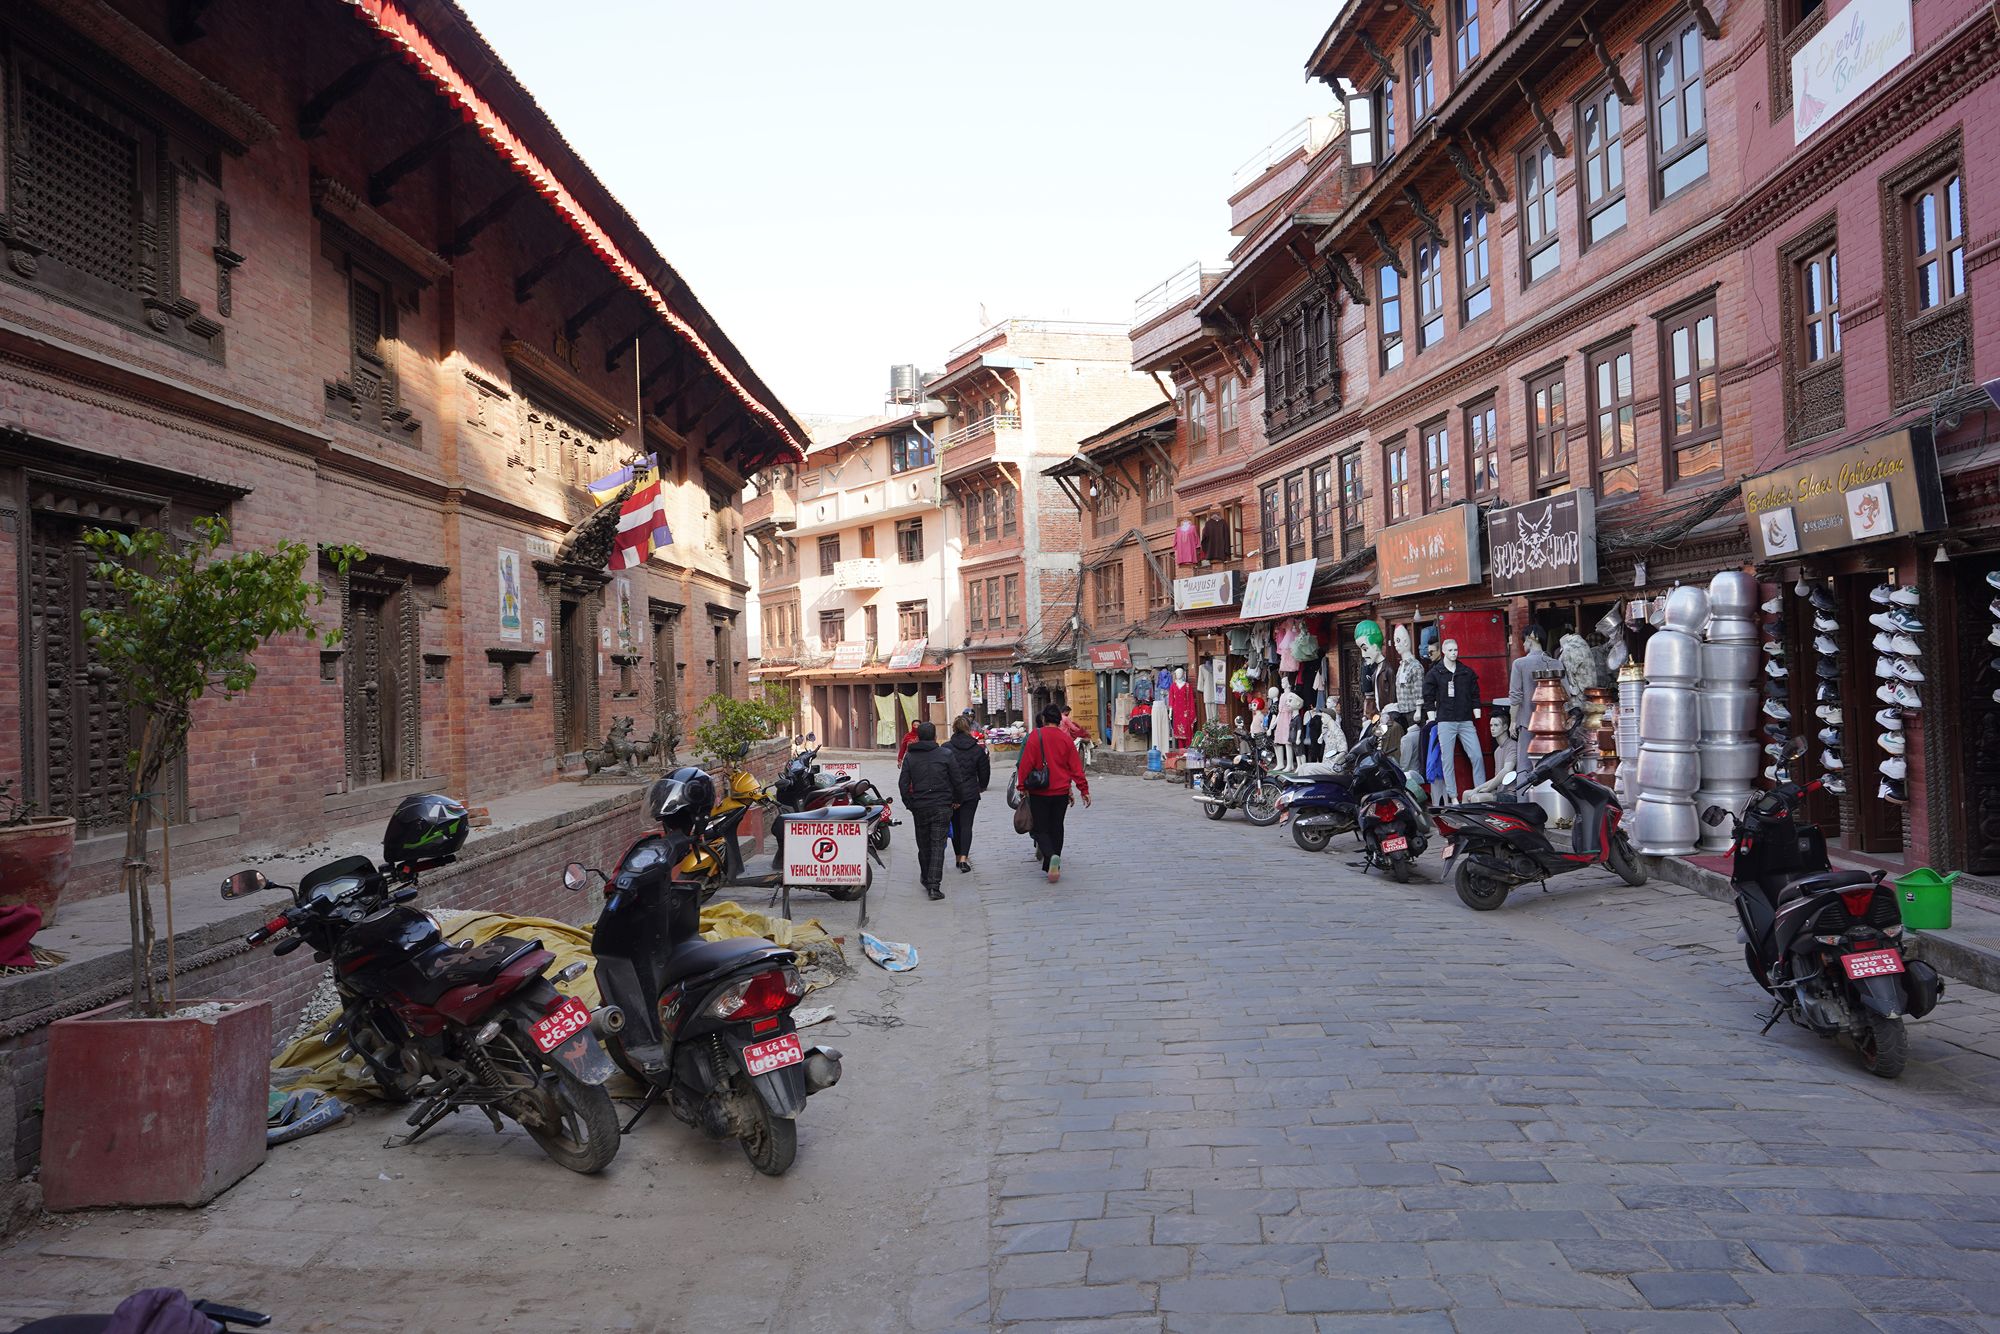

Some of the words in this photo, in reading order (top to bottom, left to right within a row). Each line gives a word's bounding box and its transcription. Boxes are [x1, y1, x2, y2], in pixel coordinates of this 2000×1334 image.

[1816, 11, 1864, 78] Everly
[1833, 21, 1906, 94] Boutique
[1797, 473, 1833, 503] Shoes
[1837, 456, 1905, 494] Collection
[790, 823, 834, 836] HERITAGE
[836, 823, 861, 836] AREA
[790, 864, 818, 877] VEHICLE
[820, 864, 830, 877] NO
[832, 864, 862, 877] PARKING
